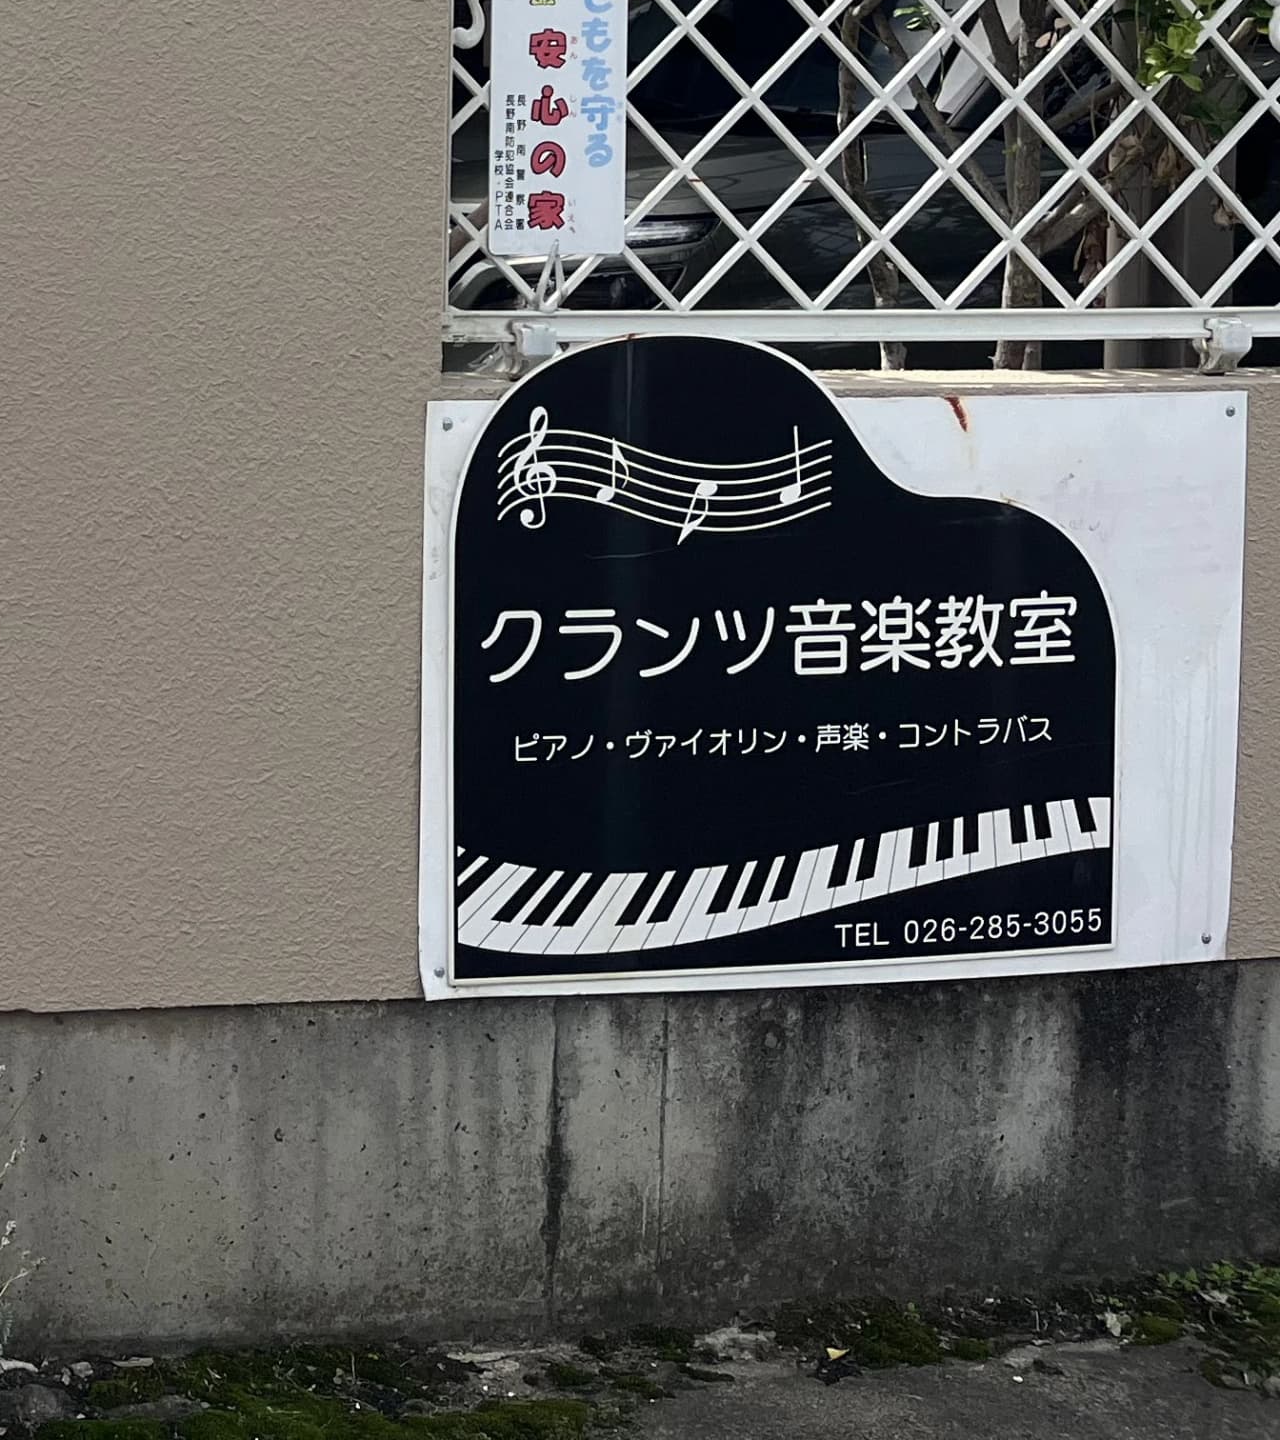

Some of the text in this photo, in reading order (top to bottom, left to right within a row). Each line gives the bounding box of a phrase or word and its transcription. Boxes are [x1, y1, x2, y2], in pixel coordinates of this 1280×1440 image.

[527, 28, 570, 230] 安心の家
[480, 589, 1078, 683] クランツ音楽教室
[514, 715, 1053, 763] ピアノ・ヴァイオリン・声楽・コントラバス
[834, 907, 1103, 949] TEL 026-285-3055
